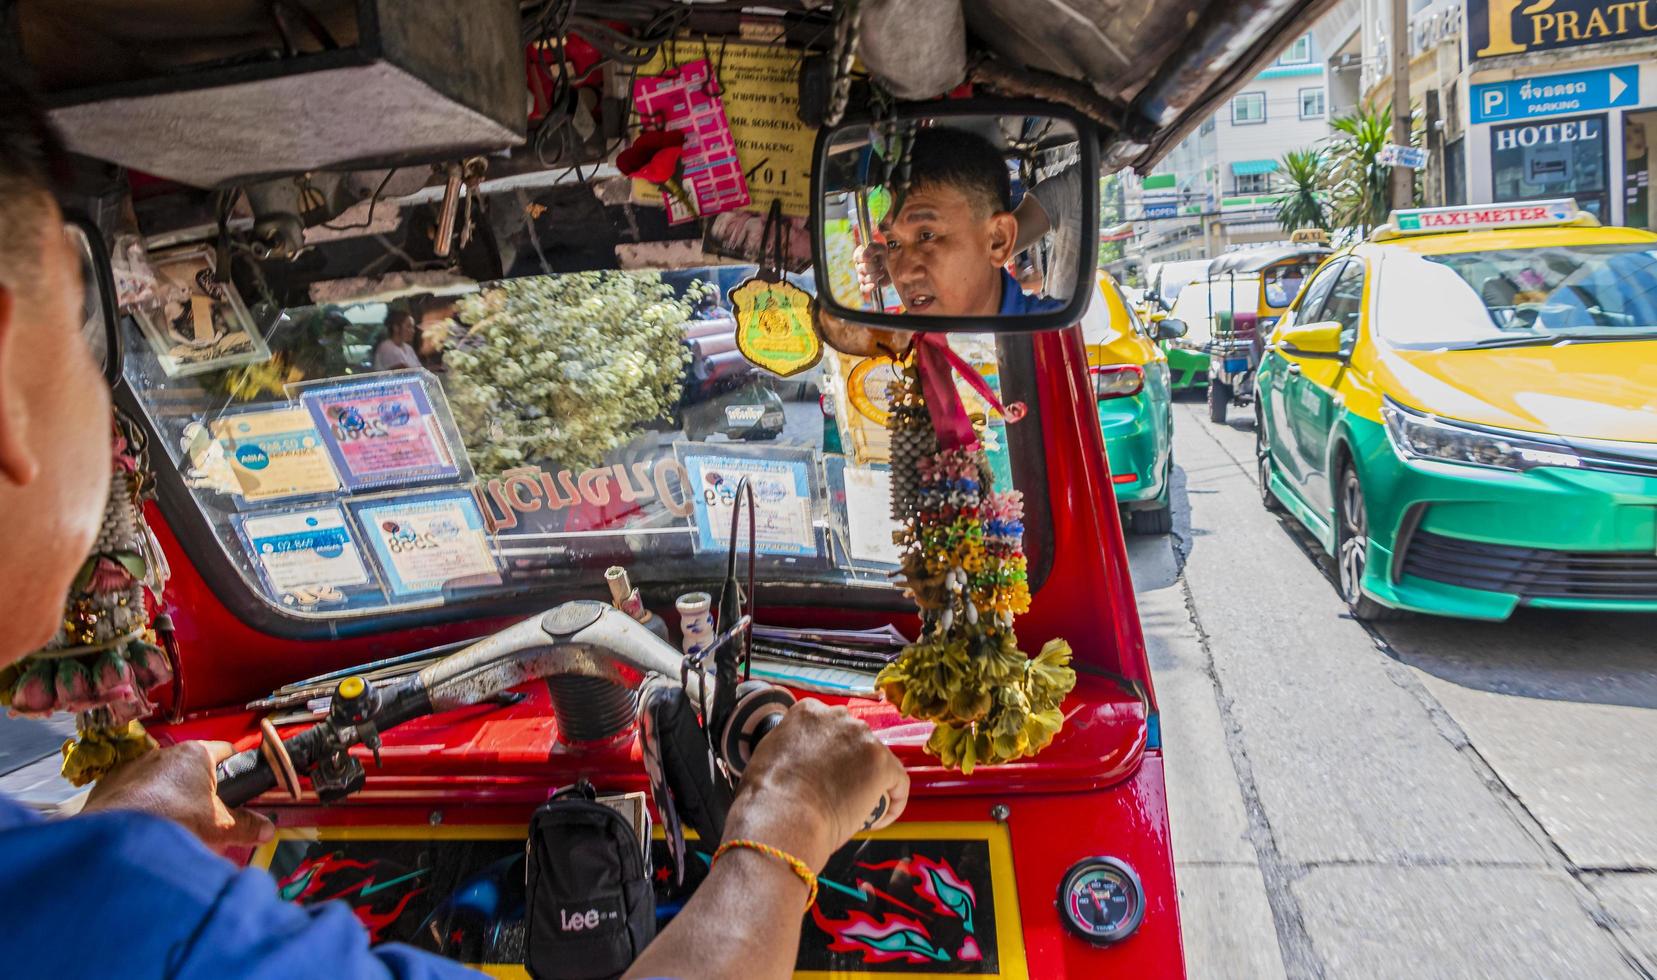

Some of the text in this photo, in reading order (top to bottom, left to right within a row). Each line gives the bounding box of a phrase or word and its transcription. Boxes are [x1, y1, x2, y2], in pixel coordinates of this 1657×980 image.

[1484, 90, 1504, 115] P
[1527, 99, 1580, 114] PARKING
[1496, 119, 1598, 150] HOTEL
[560, 909, 600, 931] Lee
